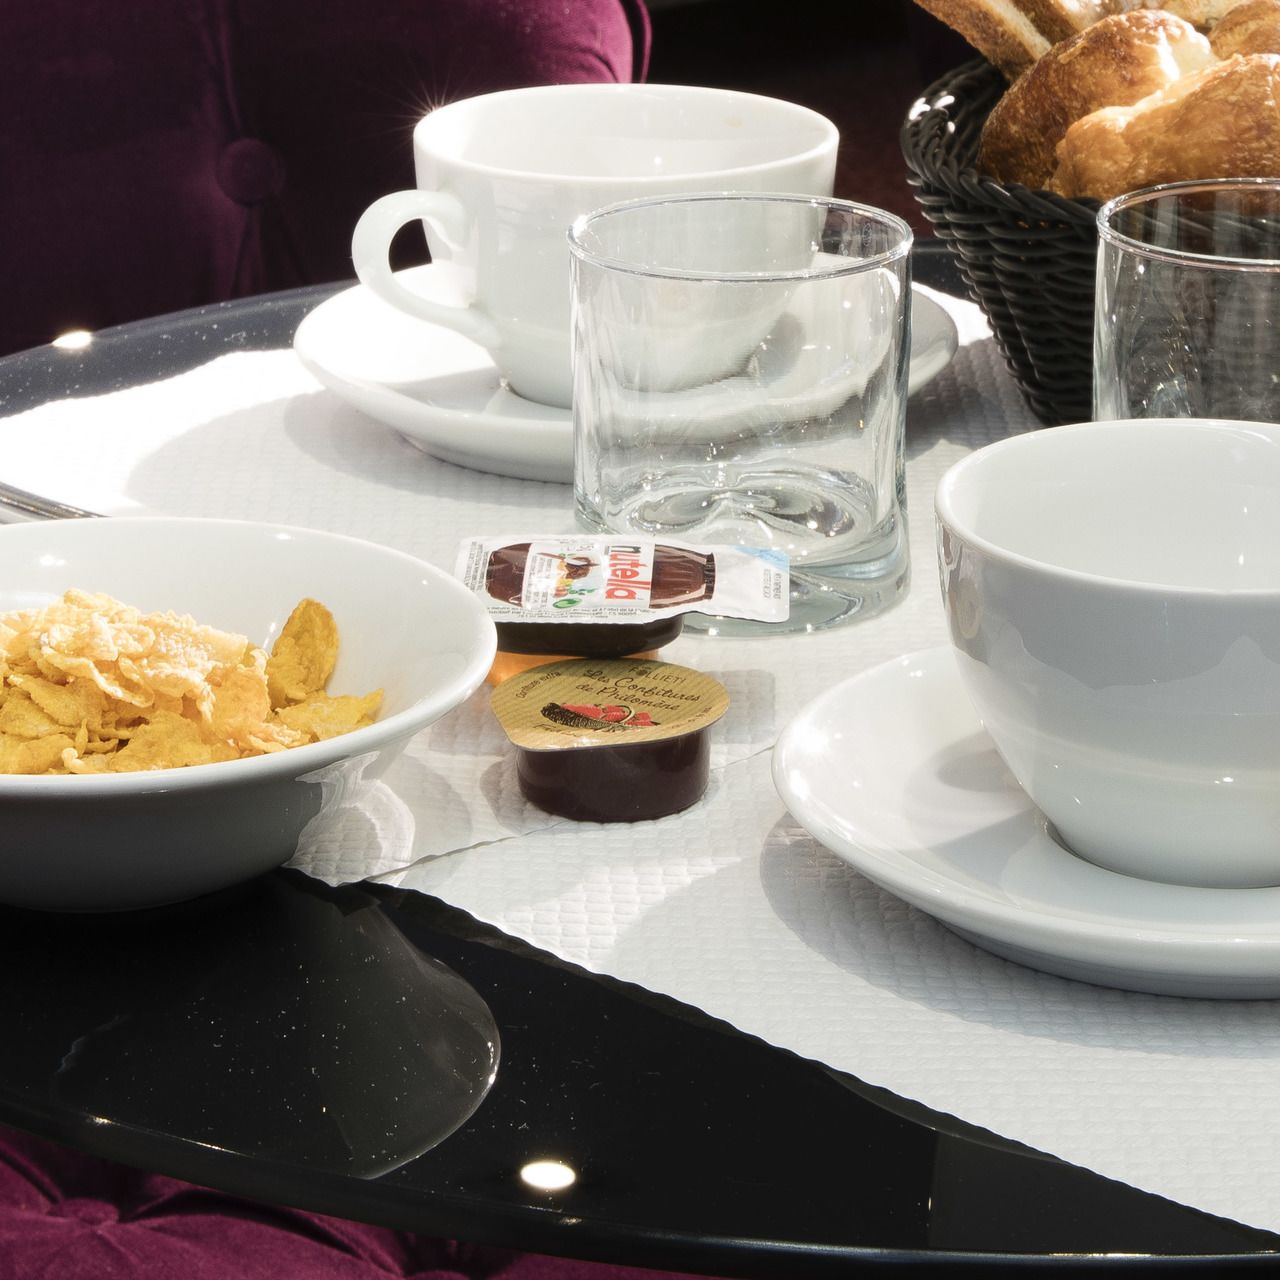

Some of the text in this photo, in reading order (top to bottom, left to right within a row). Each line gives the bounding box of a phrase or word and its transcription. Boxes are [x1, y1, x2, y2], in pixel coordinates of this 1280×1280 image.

[605, 545, 651, 600] nutella
[575, 683, 594, 692] de
[583, 669, 701, 703] Les Confitures
